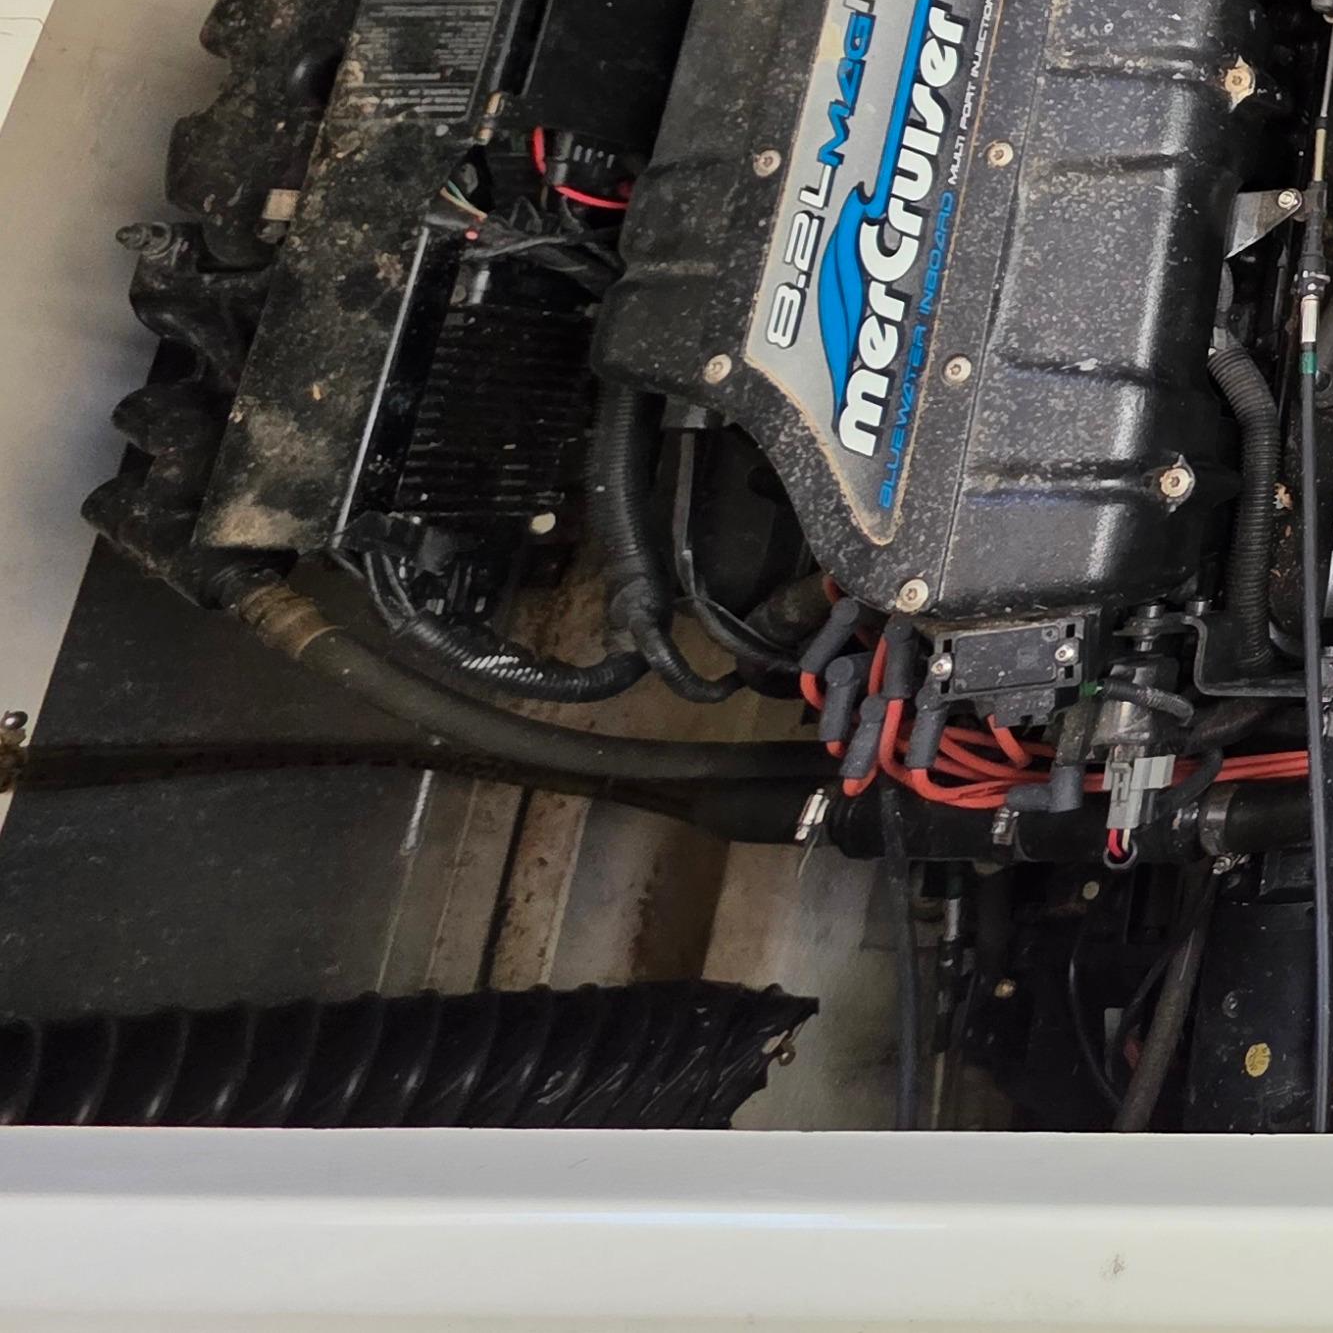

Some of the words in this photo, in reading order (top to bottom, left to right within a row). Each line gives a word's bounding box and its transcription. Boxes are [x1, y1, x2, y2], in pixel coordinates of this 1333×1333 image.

[878, 323, 928, 510] BLUEWATER
[919, 190, 954, 316] INBOARD
[947, 135, 966, 186] MULTI
[959, 81, 979, 130] PORT
